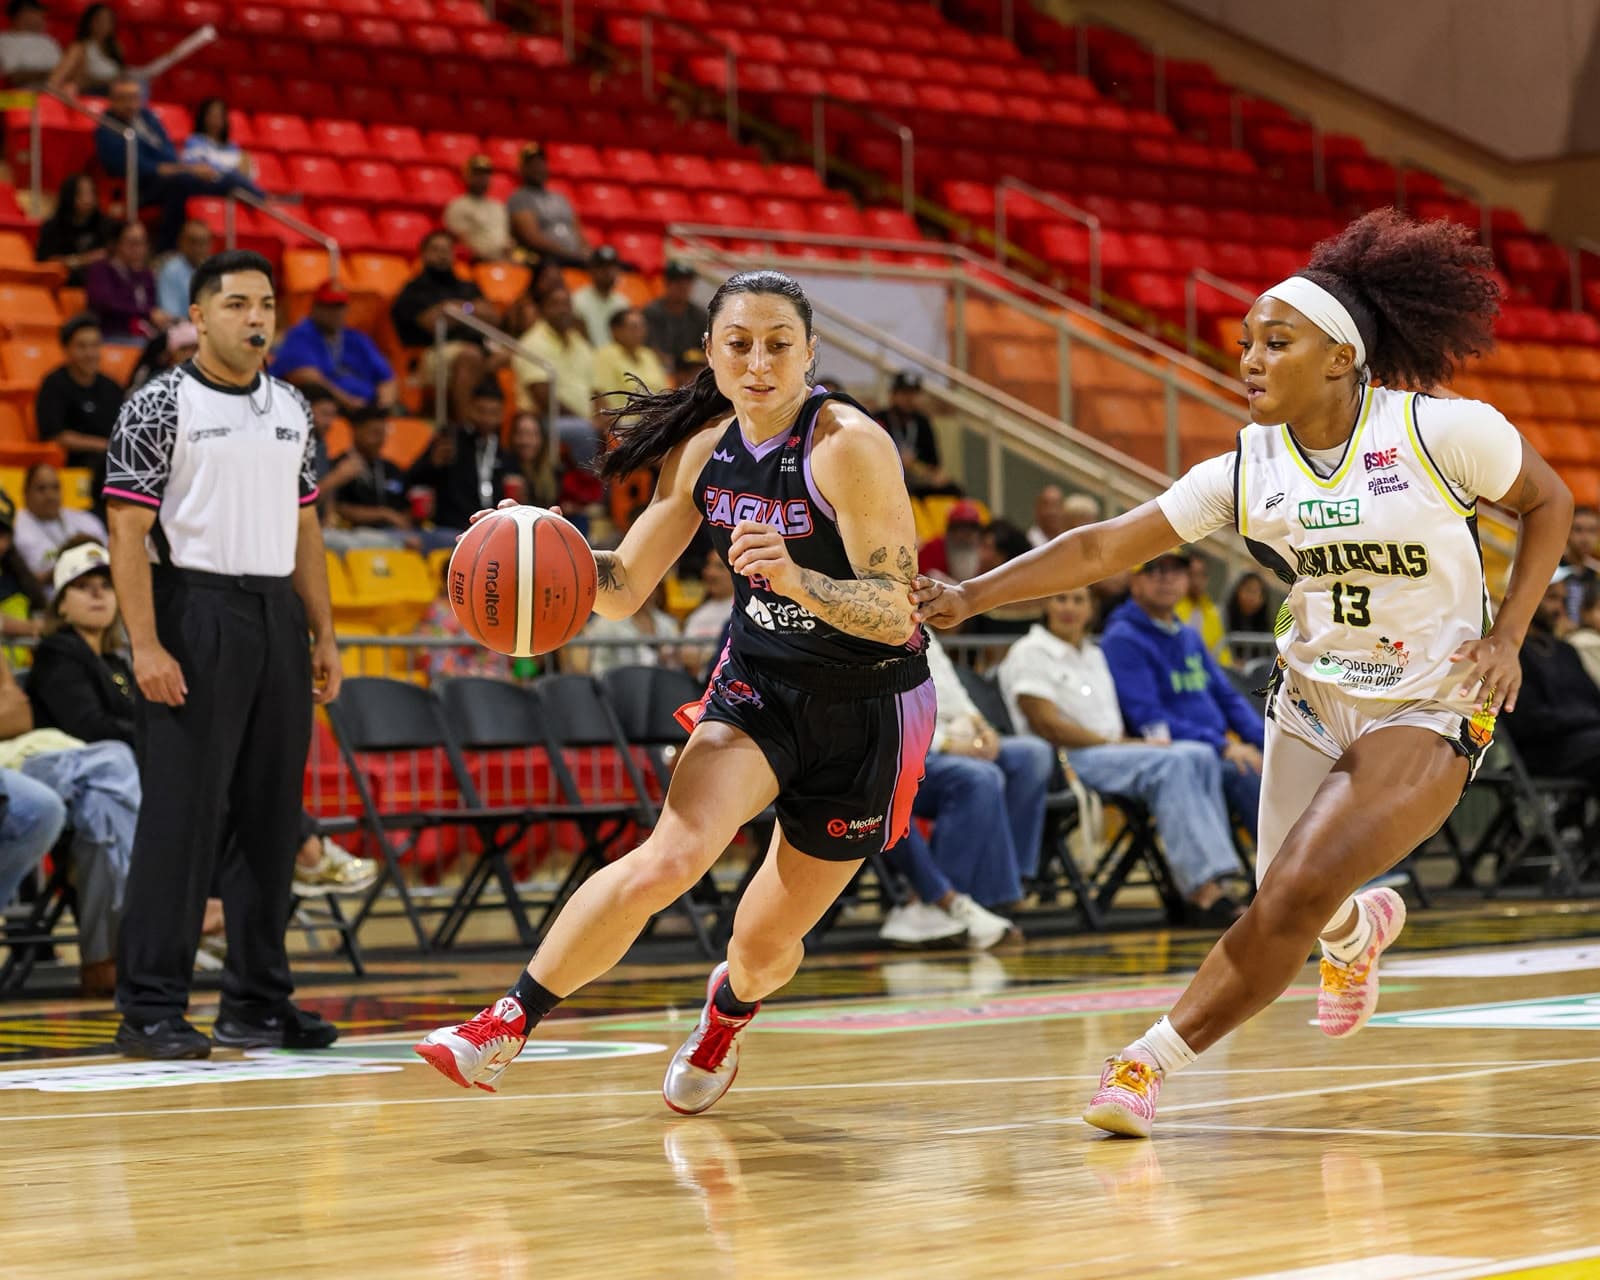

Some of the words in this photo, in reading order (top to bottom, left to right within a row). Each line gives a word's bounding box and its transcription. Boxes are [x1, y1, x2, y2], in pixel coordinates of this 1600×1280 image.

[1367, 473, 1400, 491] planet
[1373, 480, 1409, 497] fitness
[1300, 502, 1358, 528] MCS
[1297, 540, 1429, 579] NARCAS
[455, 571, 465, 606] FIBA
[485, 560, 500, 627] molten
[766, 602, 815, 619] CAGU
[1332, 582, 1371, 627] 13
